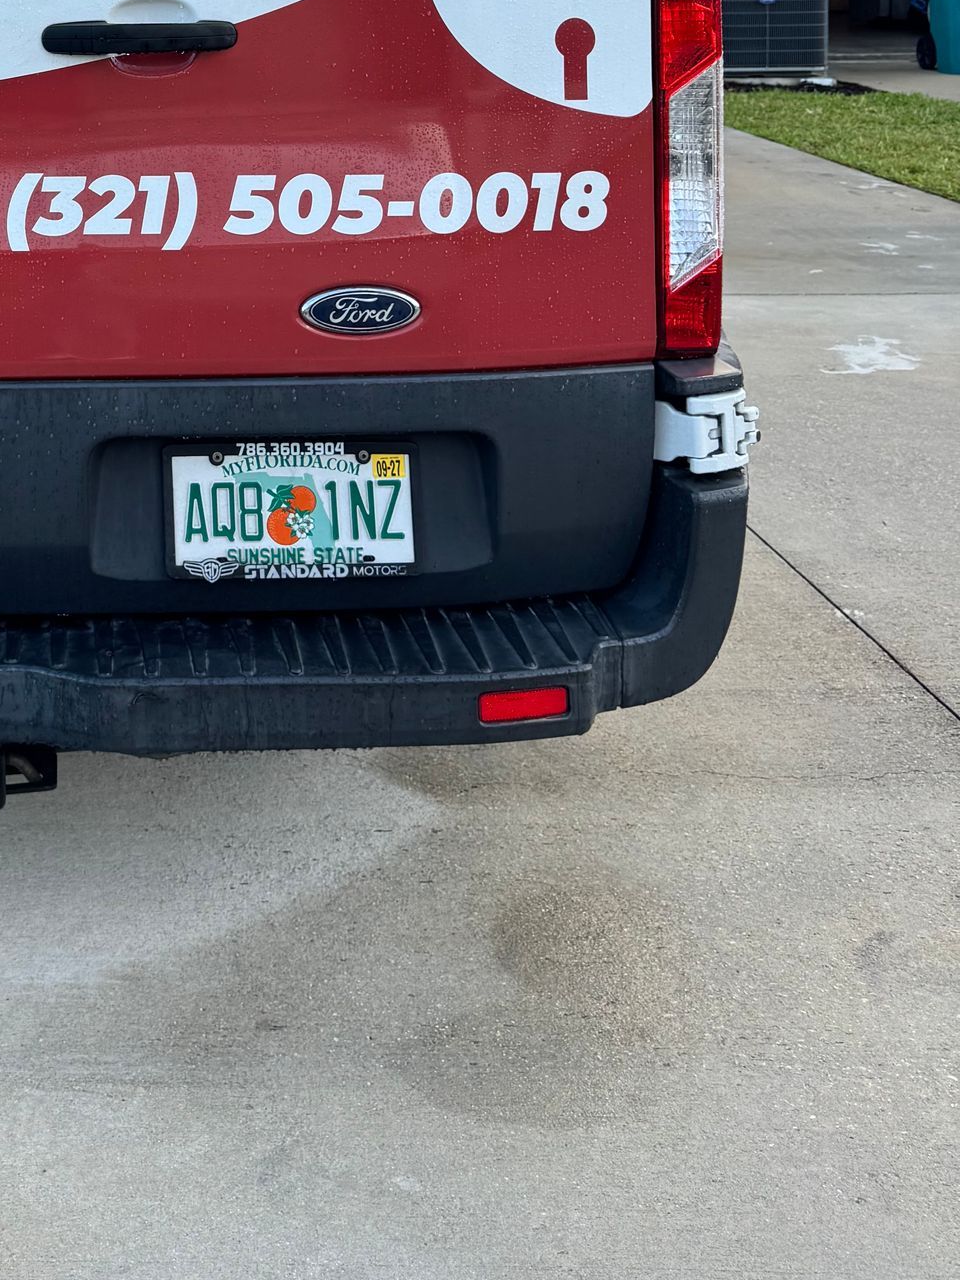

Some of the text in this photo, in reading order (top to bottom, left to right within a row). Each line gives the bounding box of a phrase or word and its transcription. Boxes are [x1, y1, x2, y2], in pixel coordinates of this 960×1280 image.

[6, 170, 610, 252] (321) 505-0018
[328, 296, 395, 324] Ford
[236, 442, 345, 456] 786.360.3904
[222, 455, 361, 478] MYFLORIDA.COM
[376, 459, 401, 477] 09-27
[185, 480, 405, 542] AQ8 1NZ
[227, 547, 364, 564] SUNSHINE STATE
[244, 564, 407, 579] STANDARD MOTORS
